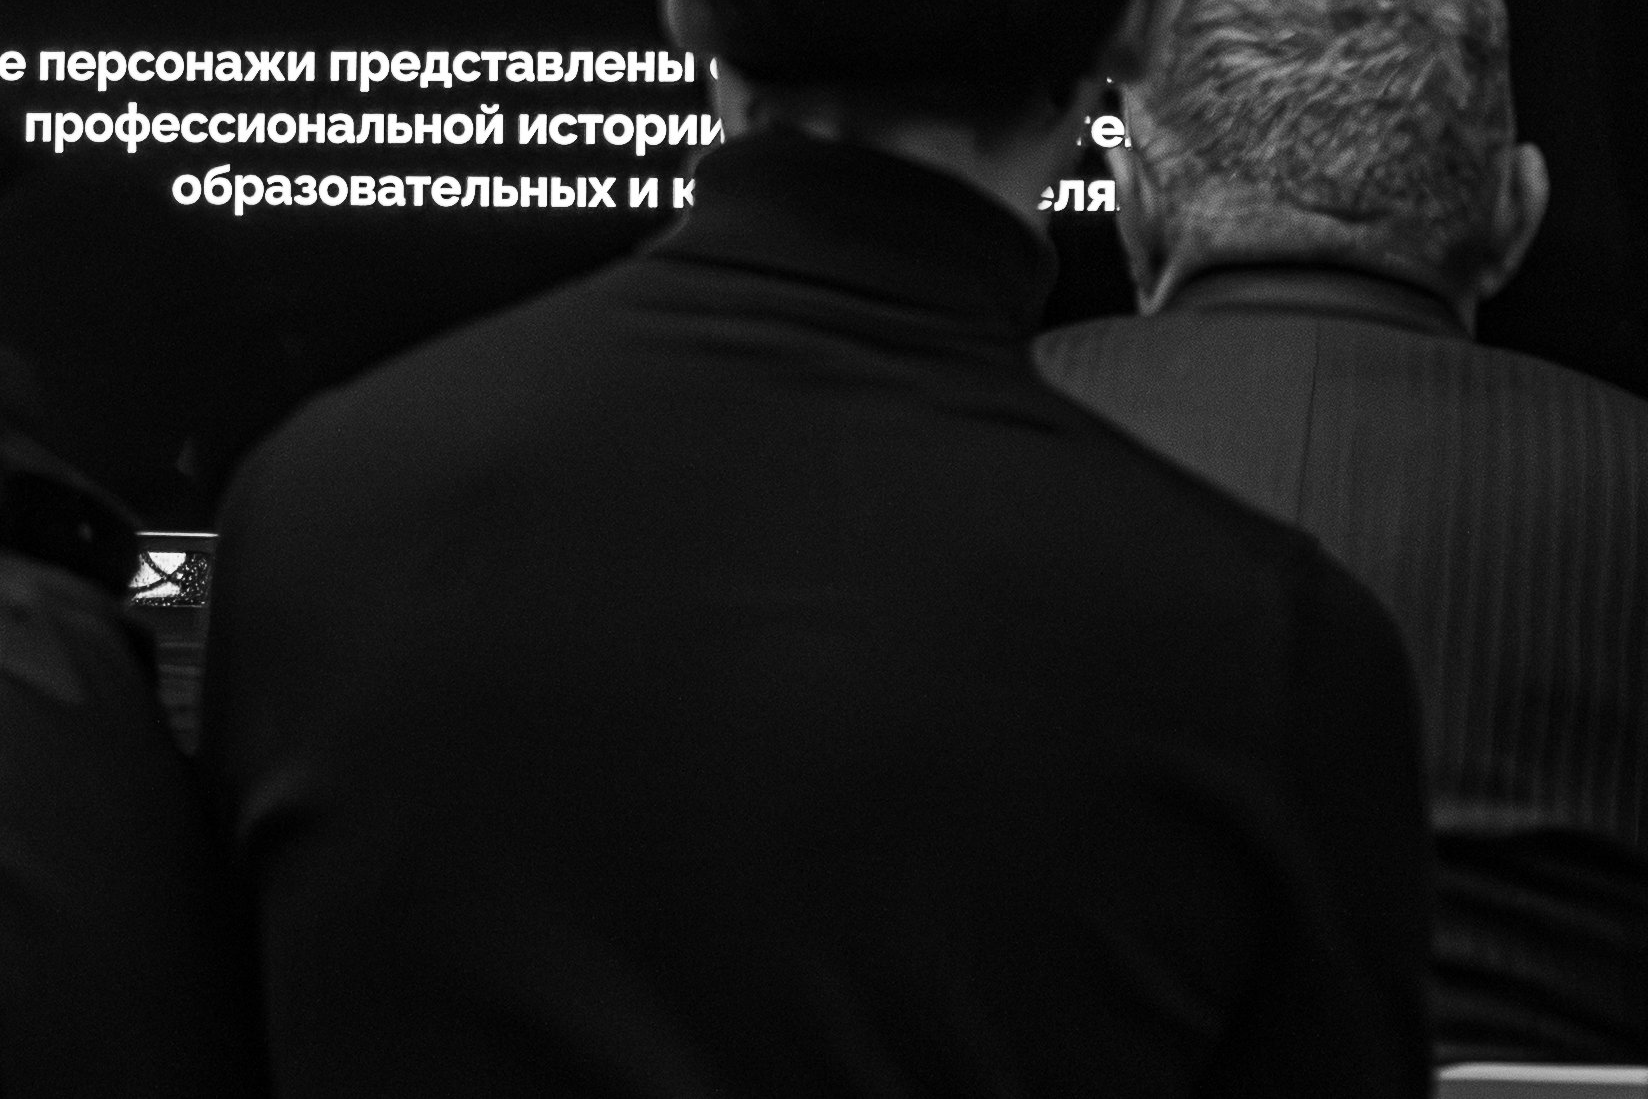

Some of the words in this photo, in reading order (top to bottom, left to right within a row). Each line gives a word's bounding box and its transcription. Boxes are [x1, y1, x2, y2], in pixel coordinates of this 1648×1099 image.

[39, 50, 316, 93] персонажи
[329, 50, 695, 93] представлены
[25, 101, 504, 154] профессиональной
[517, 113, 726, 157] истории
[171, 163, 617, 217] образовательных
[628, 177, 659, 209] и
